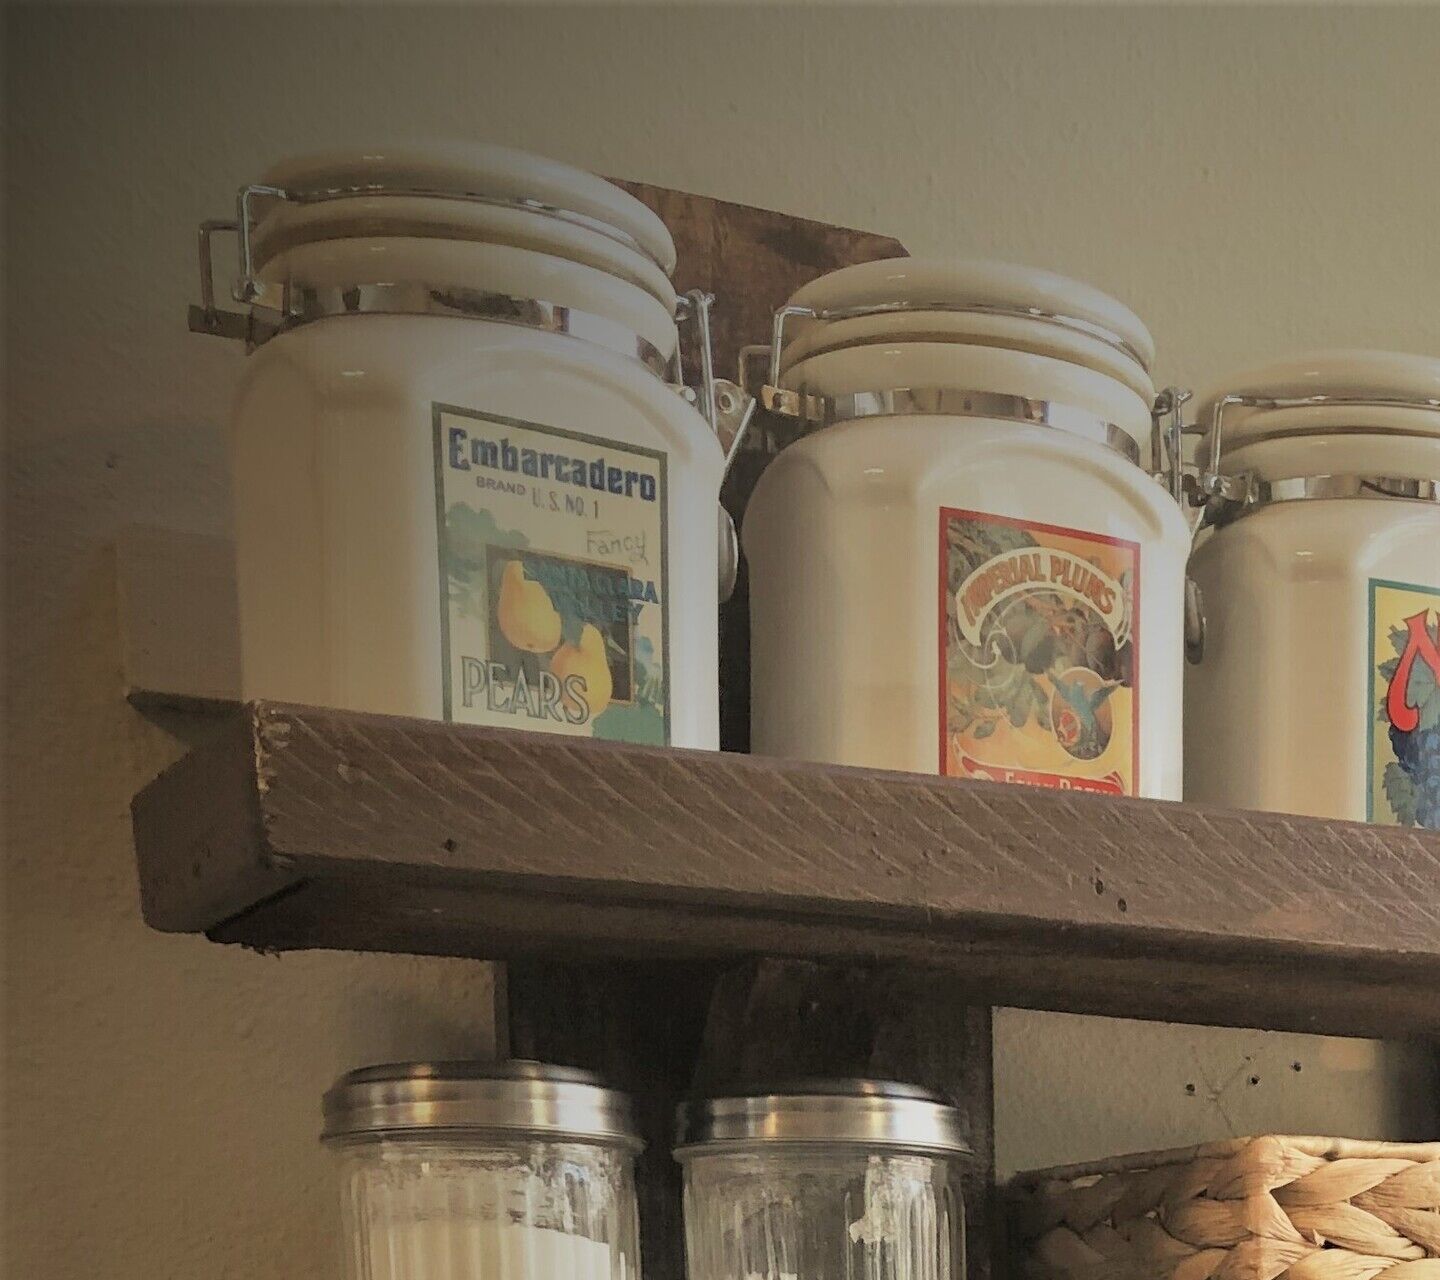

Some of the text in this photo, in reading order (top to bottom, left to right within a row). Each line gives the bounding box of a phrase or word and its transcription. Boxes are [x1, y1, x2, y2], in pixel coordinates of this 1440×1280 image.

[448, 427, 656, 502] Embarcadero
[476, 475, 526, 496] BRAND
[586, 530, 648, 565] Fancy
[1049, 555, 1116, 614] PLUMS
[461, 655, 590, 726] PEARS
